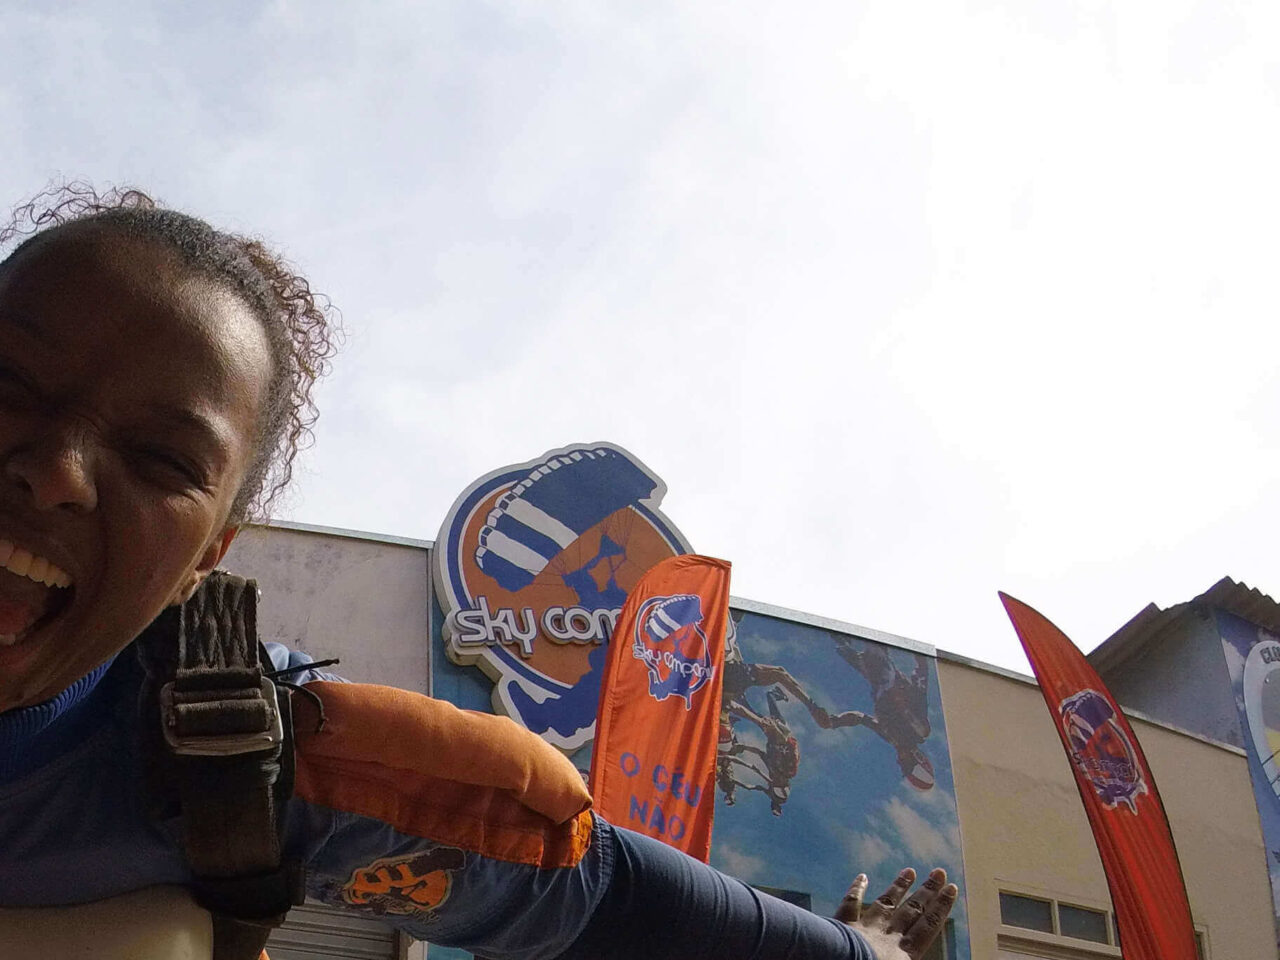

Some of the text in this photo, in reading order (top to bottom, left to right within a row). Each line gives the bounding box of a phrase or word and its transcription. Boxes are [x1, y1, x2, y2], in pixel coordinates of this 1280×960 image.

[455, 596, 537, 654] sky
[620, 752, 701, 808] O CÉU
[629, 794, 685, 841] NÃO
